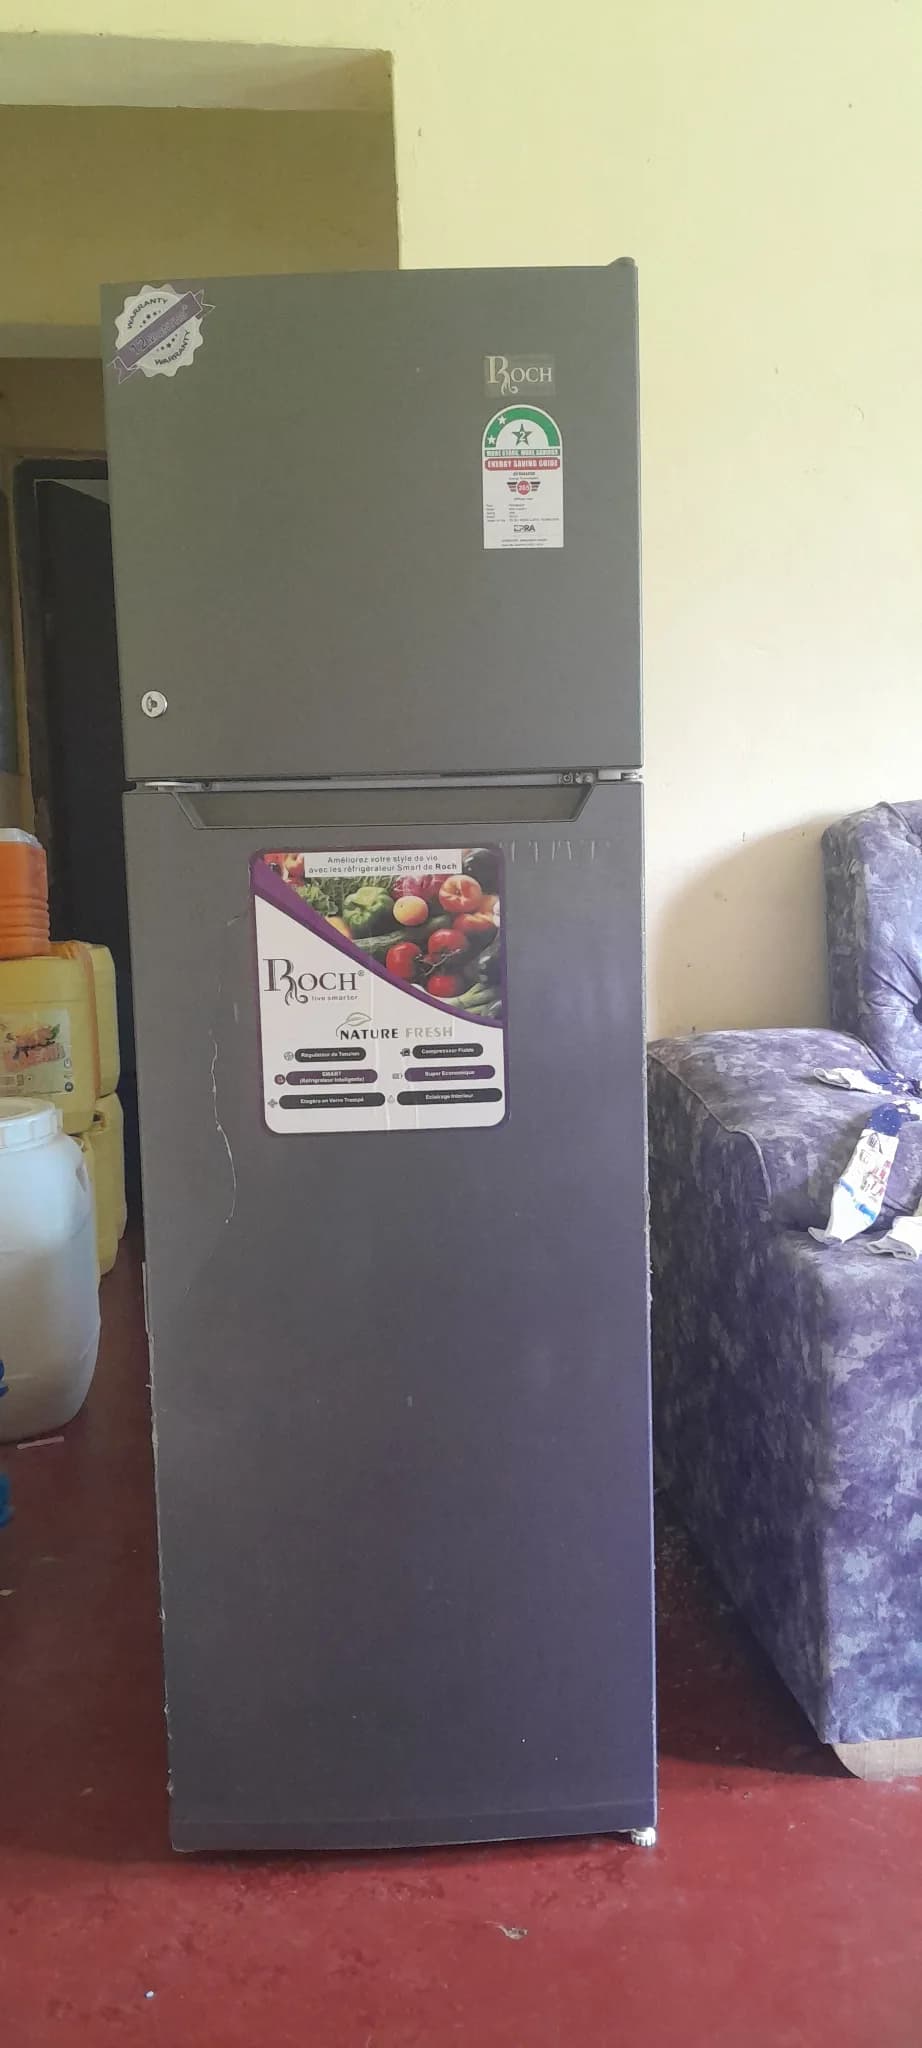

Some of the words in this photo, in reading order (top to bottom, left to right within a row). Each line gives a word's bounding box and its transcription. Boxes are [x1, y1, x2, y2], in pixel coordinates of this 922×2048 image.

[127, 297, 168, 330] WARRANTY
[154, 330, 191, 365] WARRANTY
[487, 460, 511, 468] ENERGY
[513, 460, 537, 468] SAVING
[538, 459, 558, 467] GUIDE
[327, 855, 368, 864] Améliorez
[393, 855, 412, 864] style
[397, 863, 421, 872] Smart
[340, 1028, 399, 1040] NATURE
[405, 1026, 453, 1038] FRESH
